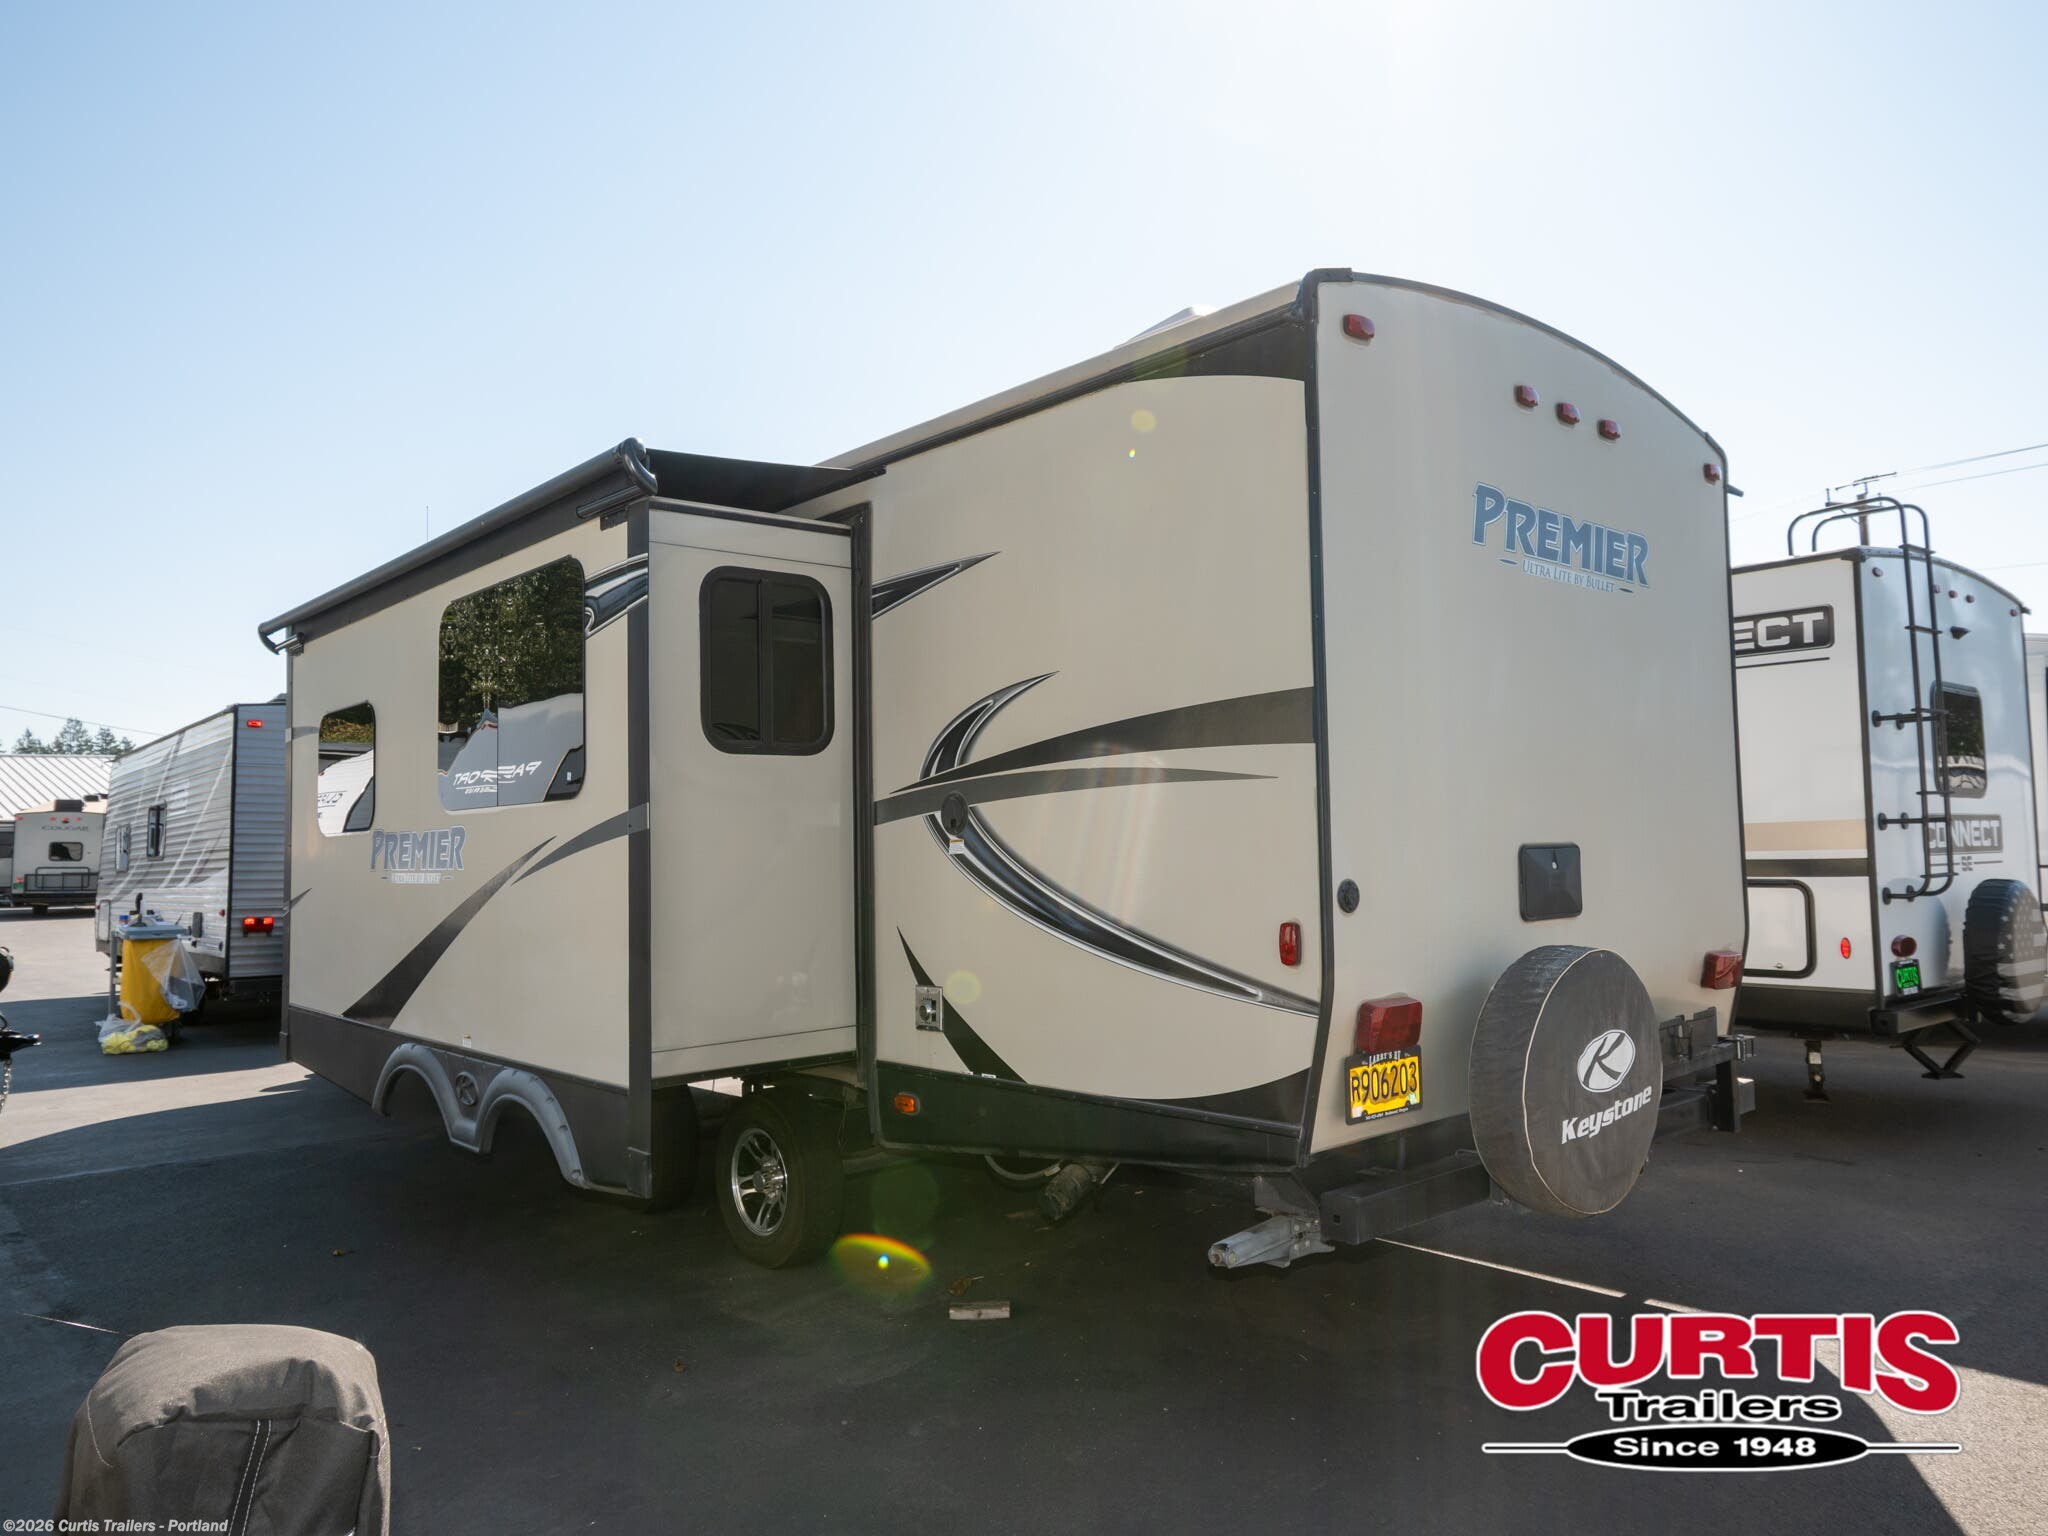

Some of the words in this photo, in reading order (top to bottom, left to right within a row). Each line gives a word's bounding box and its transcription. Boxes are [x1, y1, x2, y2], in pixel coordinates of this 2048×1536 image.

[1472, 481, 1649, 588] PREMIER
[1523, 559, 1552, 578] ULTRA
[1553, 566, 1572, 585] LITE
[1586, 575, 1616, 593] BULLET
[370, 825, 465, 871] PREMIER
[1351, 1061, 1417, 1103] R906203
[1561, 1086, 1652, 1145] Keystone
